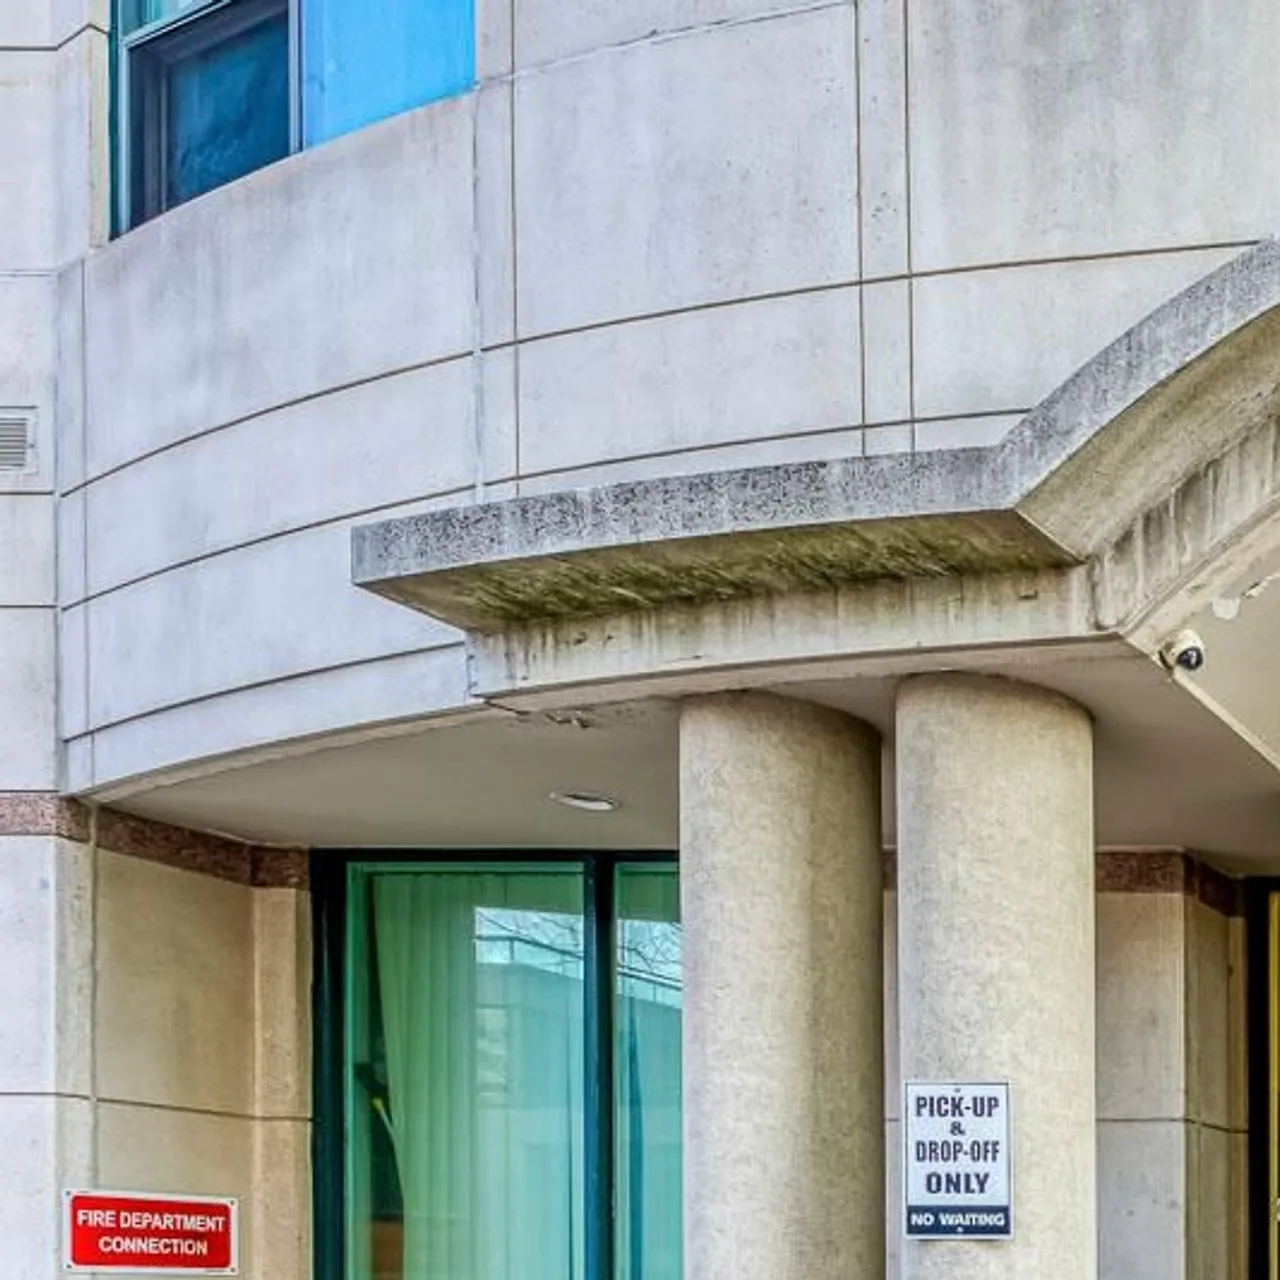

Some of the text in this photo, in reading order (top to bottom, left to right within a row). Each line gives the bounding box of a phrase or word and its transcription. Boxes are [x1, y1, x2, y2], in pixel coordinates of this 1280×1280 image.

[915, 1096, 999, 1117] PICK-UP
[950, 1121, 965, 1136] &
[915, 1140, 1000, 1162] DROP-OFF
[926, 1172, 990, 1194] ONLY
[77, 1210, 225, 1231] FIRE DEPARTMENT
[911, 1213, 1005, 1226] NO WAITING
[98, 1236, 208, 1255] CONNECTION
